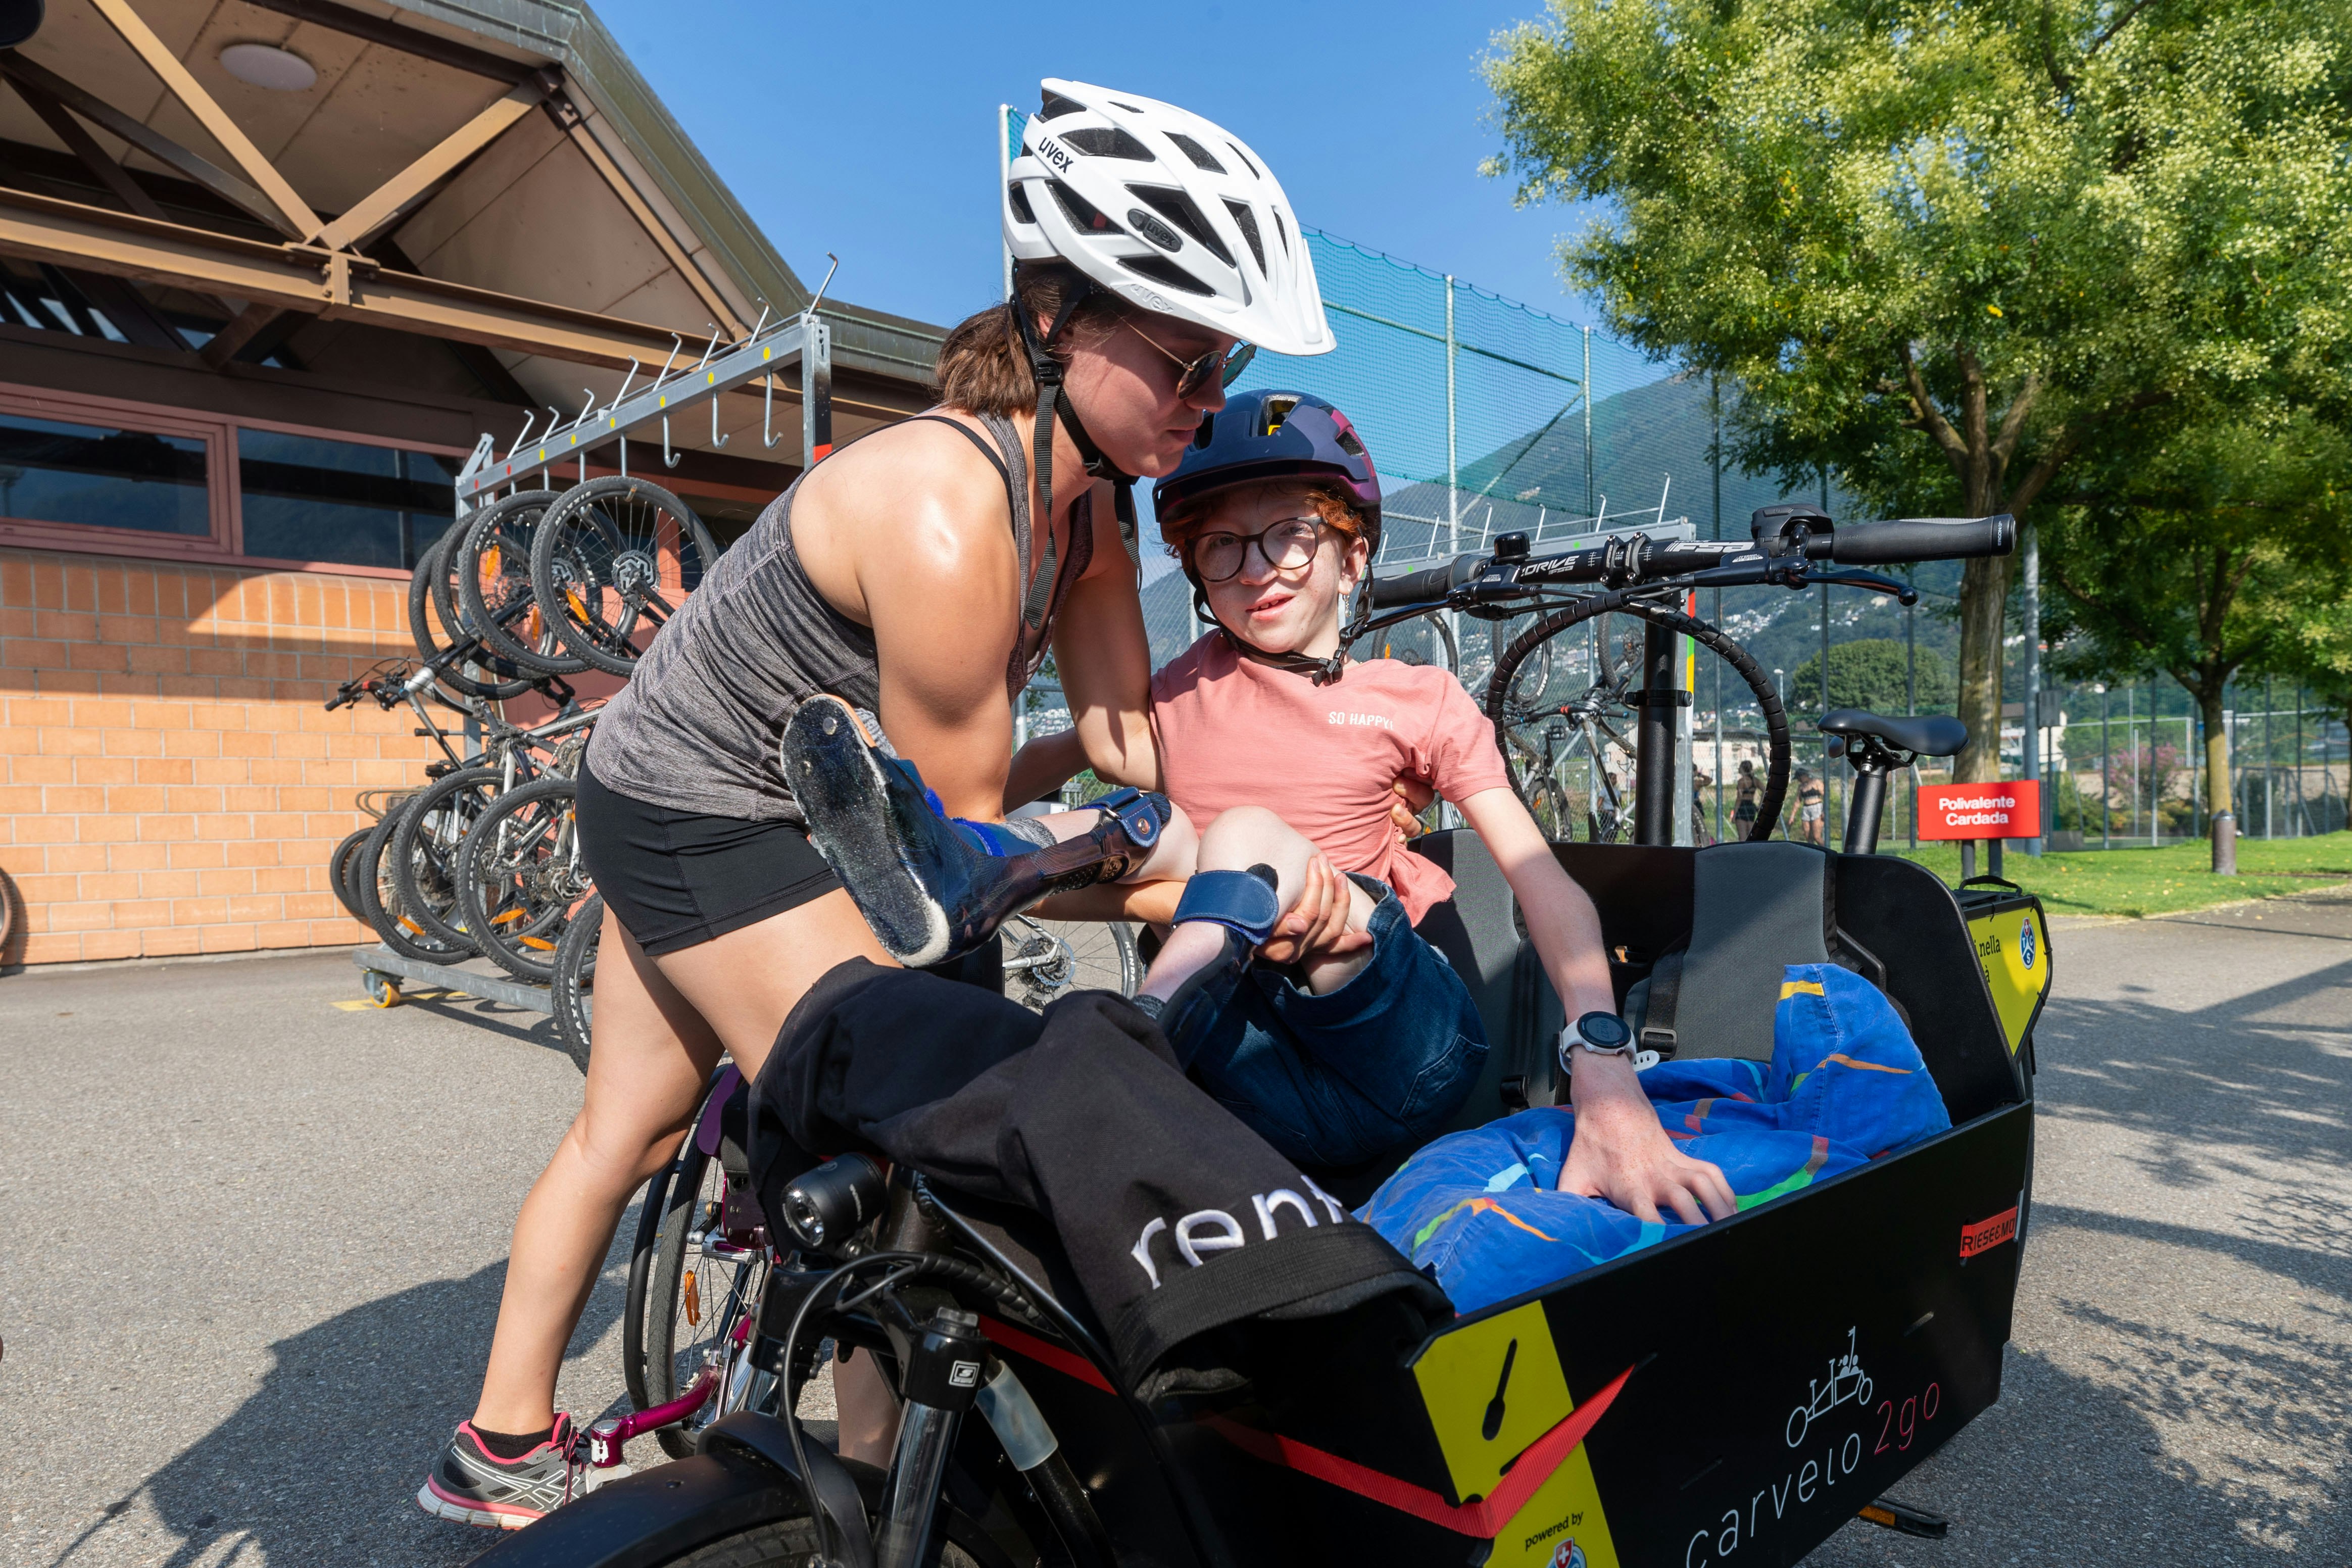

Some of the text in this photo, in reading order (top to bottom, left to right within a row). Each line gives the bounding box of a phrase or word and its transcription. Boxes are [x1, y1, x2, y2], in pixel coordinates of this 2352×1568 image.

[1038, 136, 1074, 173] uvex
[1147, 222, 1175, 248] uvex
[1131, 284, 1173, 313] uvex
[555, 491, 592, 526] MAXXIS
[1329, 711, 1345, 725] SO
[1939, 796, 2016, 811] Polivalente
[1946, 811, 2008, 826] Cardada
[469, 837, 483, 892] MAXXIS
[1124, 941, 1136, 982] KENDA
[1979, 935, 2001, 957] nella
[568, 977, 590, 1045] MAXXIS
[1525, 1511, 1583, 1552] powered by
